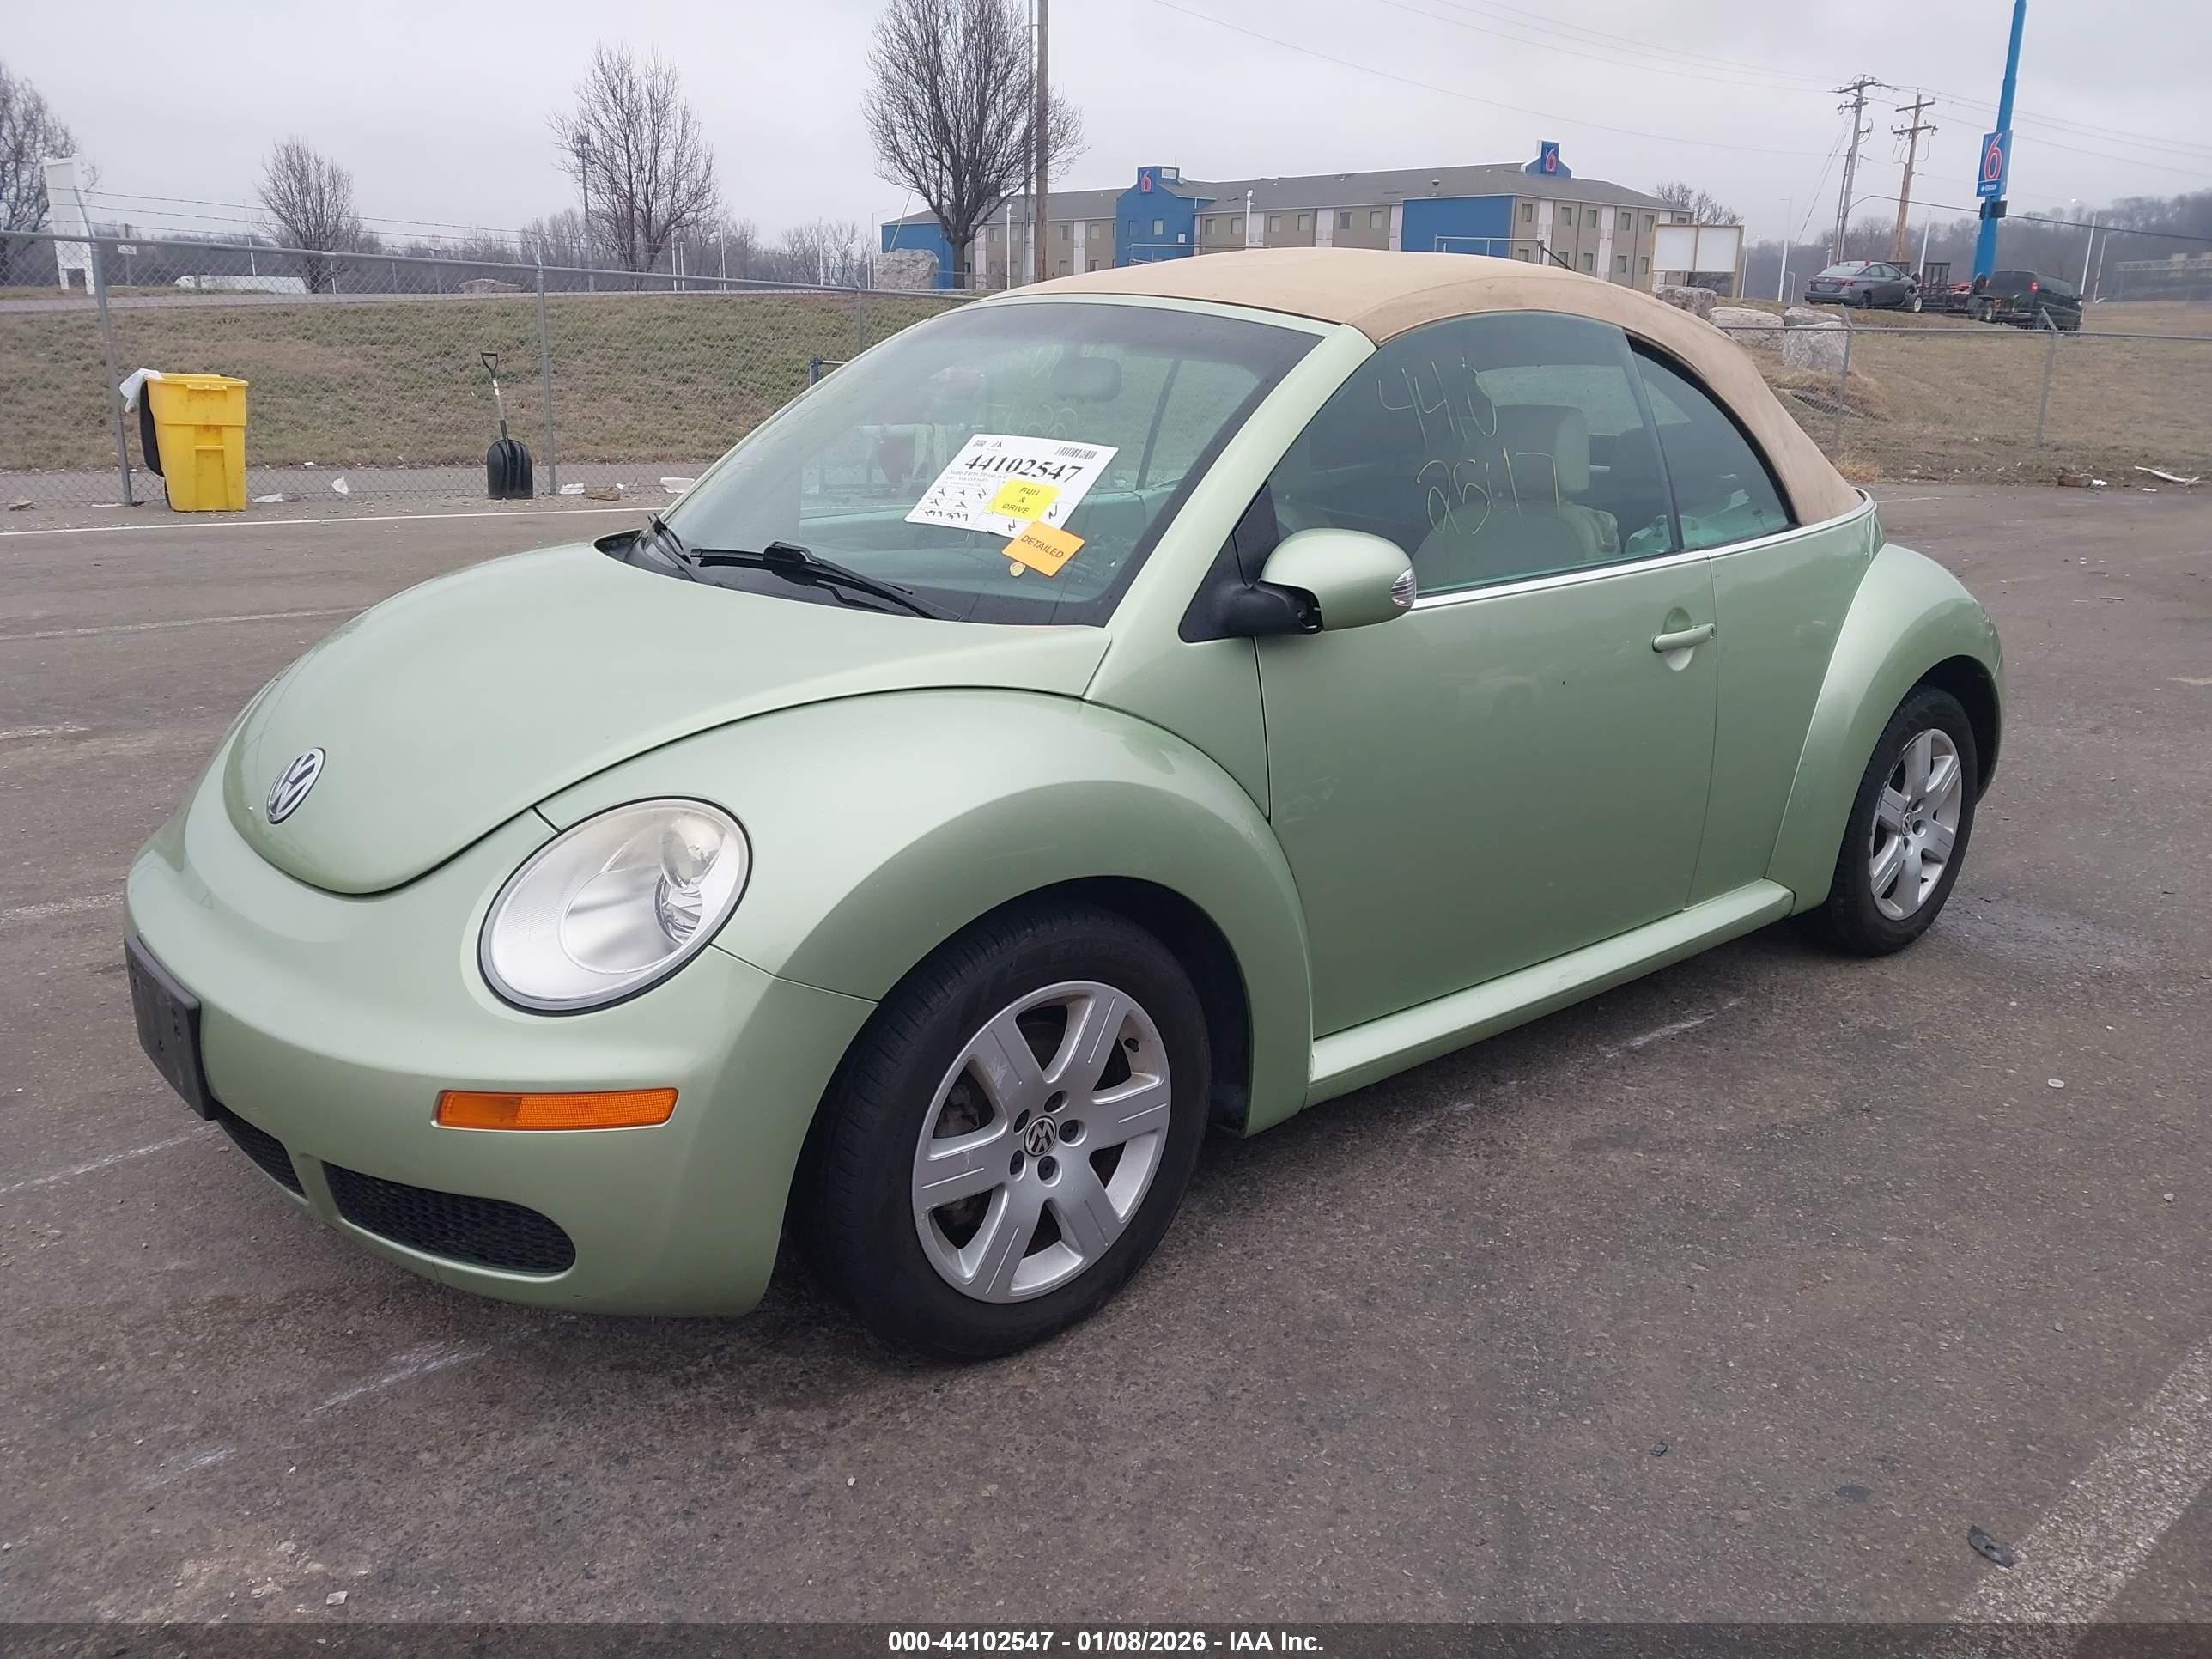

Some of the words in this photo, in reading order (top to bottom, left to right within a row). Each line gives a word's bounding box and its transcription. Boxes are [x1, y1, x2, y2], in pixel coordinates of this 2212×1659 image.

[1546, 147, 1557, 173] 6
[1984, 133, 2002, 180] 6
[1140, 170, 1152, 193] 6
[964, 453, 1084, 483] 44102547
[1019, 487, 1040, 495] RUN
[1001, 503, 1030, 514] DRIVE
[1021, 534, 1065, 559] DETAILED
